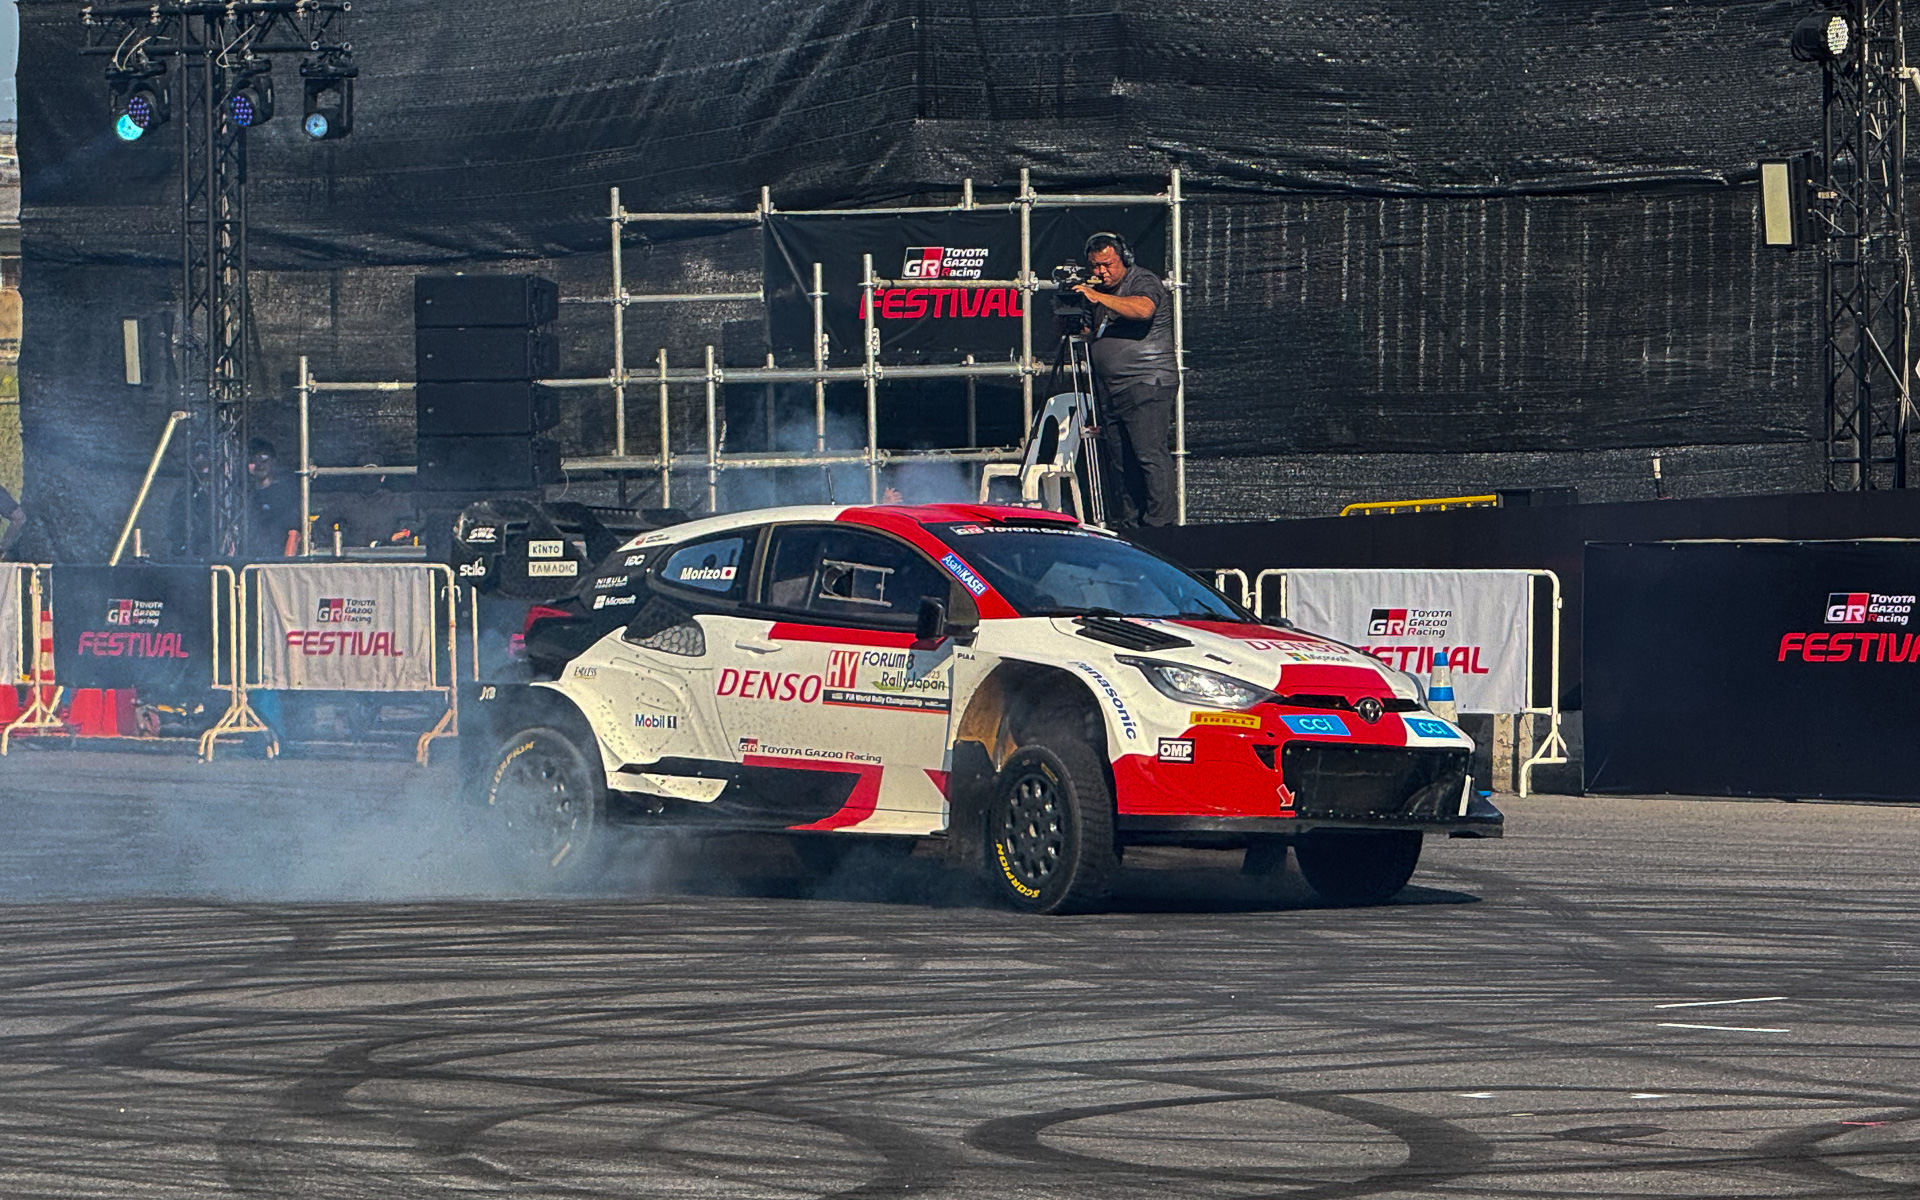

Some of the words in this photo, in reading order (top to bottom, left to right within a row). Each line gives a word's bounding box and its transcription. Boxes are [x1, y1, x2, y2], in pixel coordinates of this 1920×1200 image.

[945, 248, 989, 257] TOYOTA
[943, 258, 984, 267] GAZOO
[941, 267, 982, 279] Racing
[858, 288, 1025, 320] FESTIVAL
[532, 544, 560, 554] KINTO
[531, 562, 576, 574] YAMADIC
[680, 567, 721, 581] Morizo
[134, 601, 164, 609] TOYOTA
[346, 599, 376, 607] TOYOTA
[605, 594, 637, 607] Microsoft
[1871, 594, 1916, 604] TOYOTA
[1411, 609, 1453, 618] TOYOTA
[1827, 604, 1866, 622] GR
[1869, 604, 1912, 613] GAZOO
[1409, 618, 1448, 627] GAZOO
[1867, 613, 1910, 625] Racing
[1368, 619, 1406, 635] GR
[1407, 628, 1446, 639] Racing
[78, 631, 189, 658] FESTIVAL
[286, 631, 404, 657] FESTIVAL
[1244, 640, 1350, 655] DENSO
[716, 668, 823, 703] DENSO
[635, 713, 665, 729] Mobil
[1195, 713, 1256, 726] PIRELLI
[1299, 718, 1335, 732] CCI
[1418, 721, 1449, 735] CCI
[760, 744, 802, 756] TOYOTA
[804, 748, 843, 759] GAZOO
[845, 751, 882, 764] Racing
[1159, 744, 1193, 758] OMP
[996, 843, 1041, 898] SCORPION
